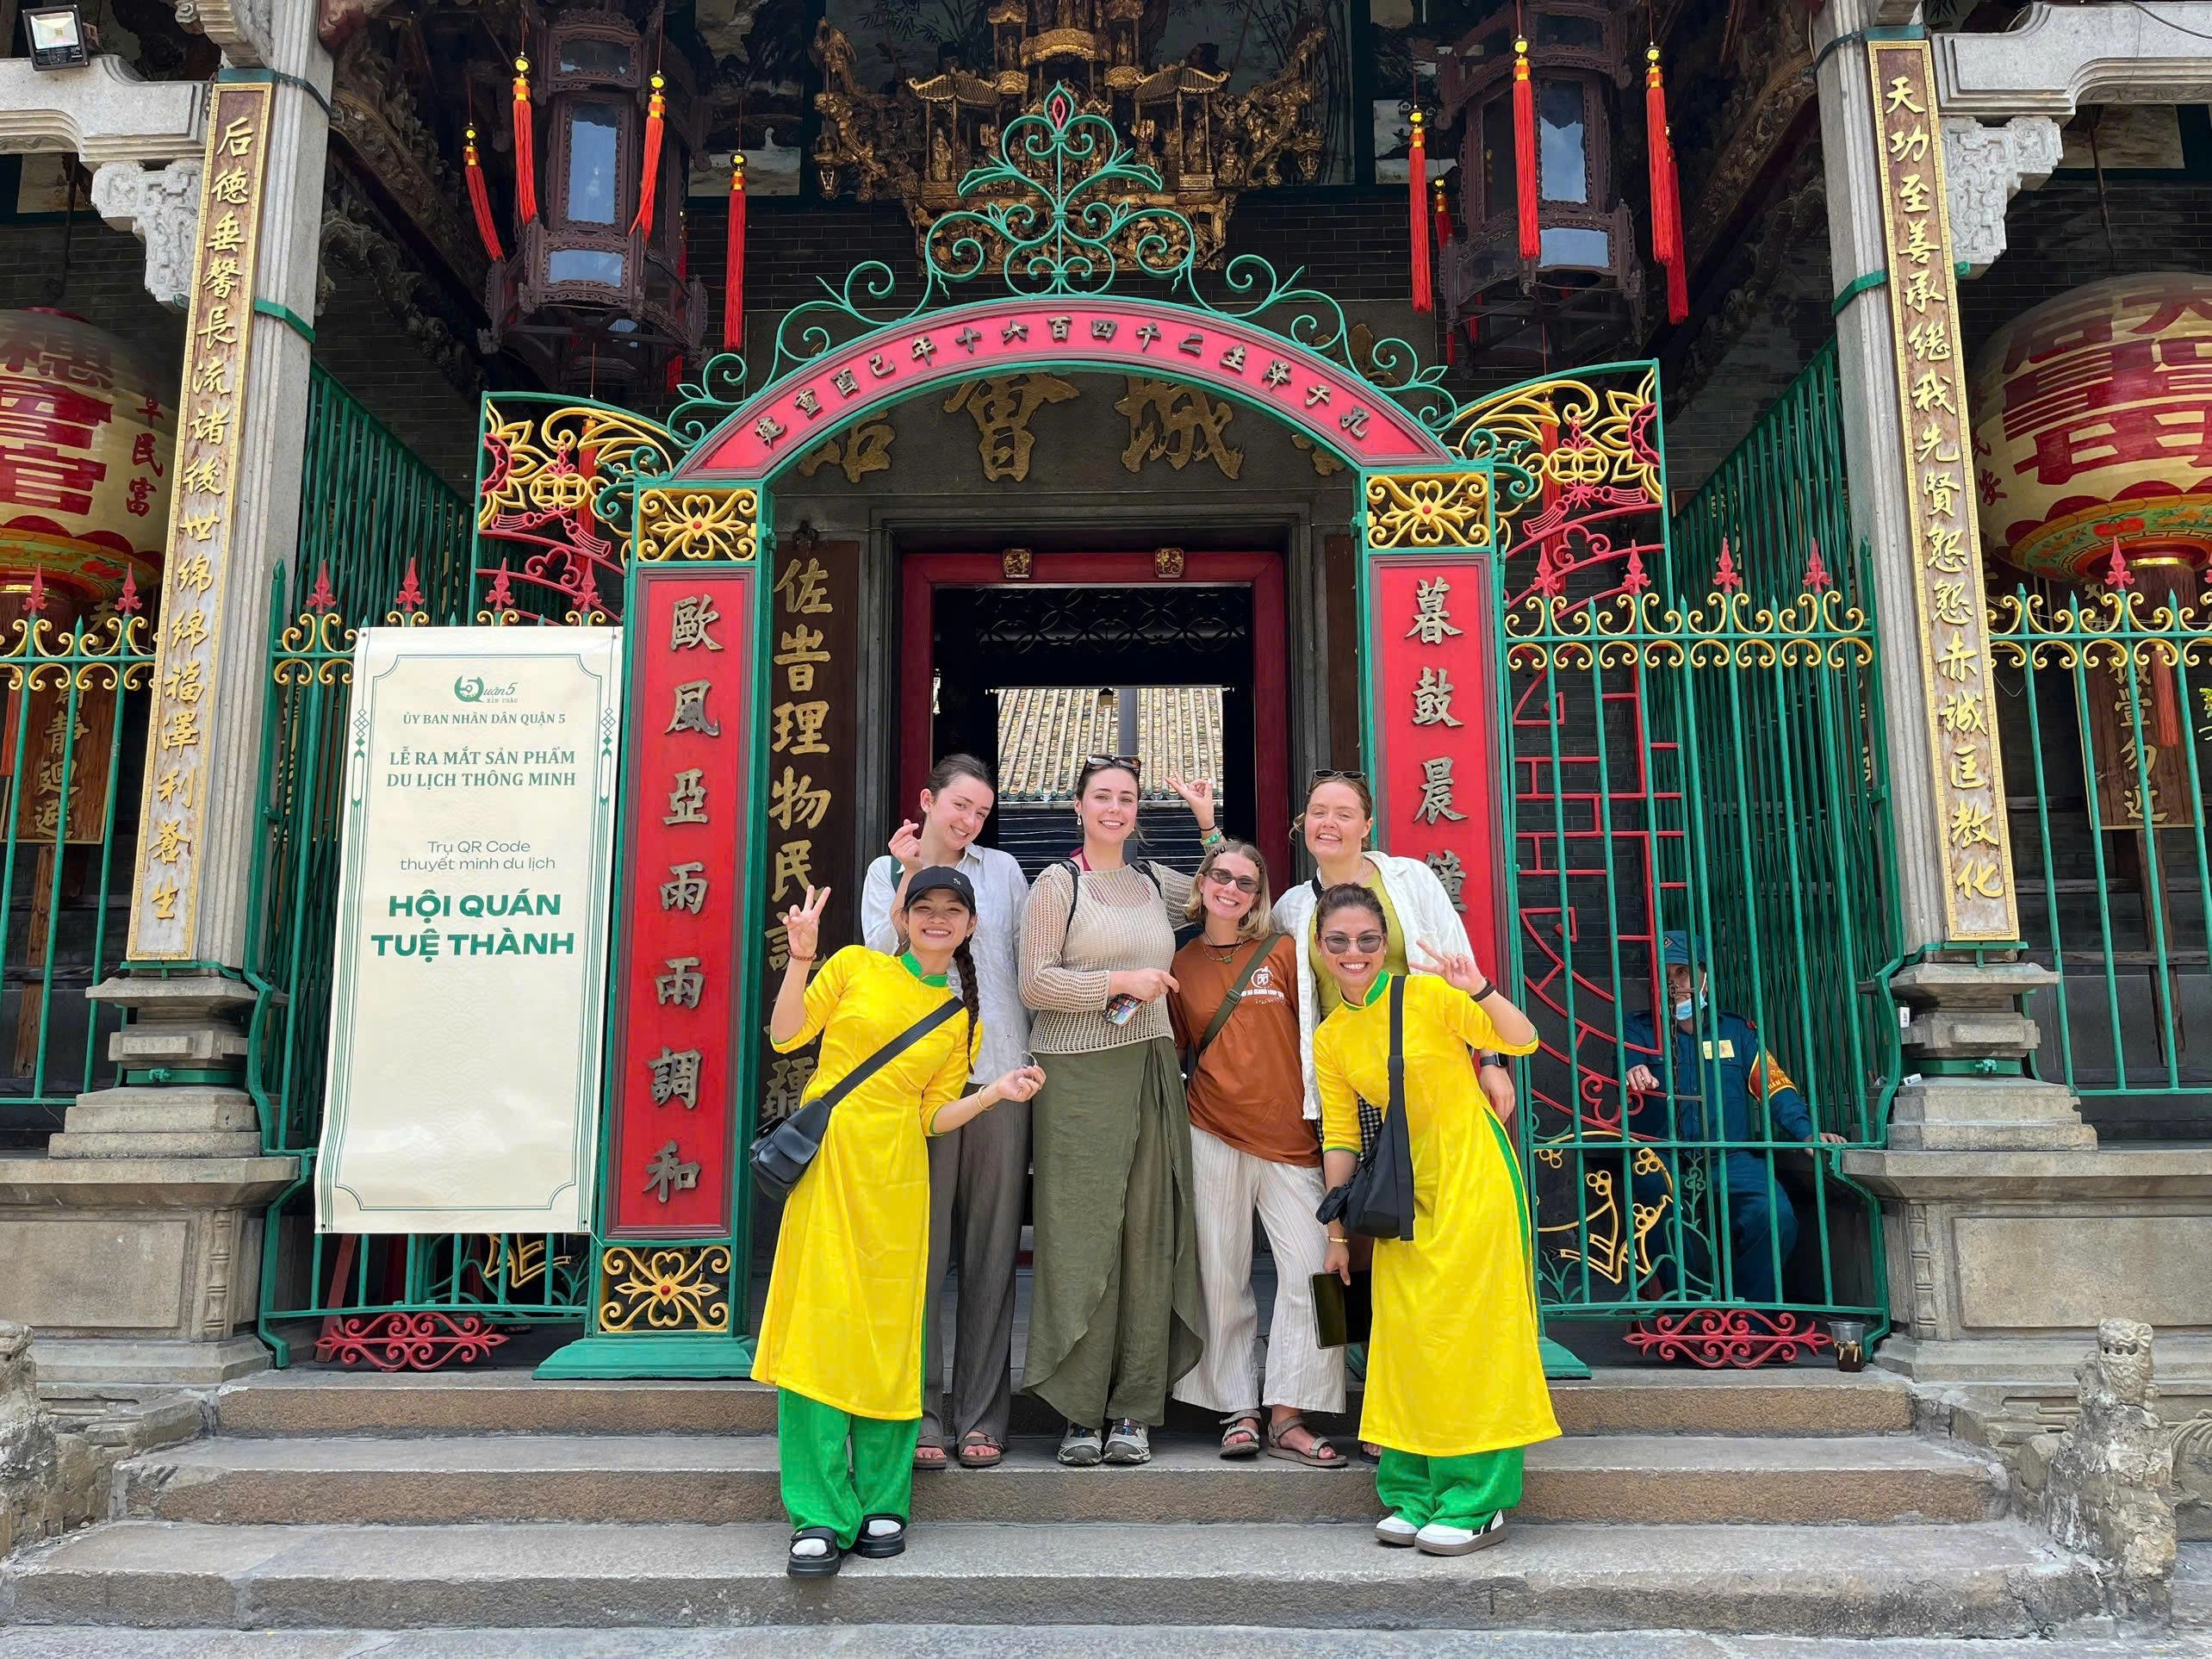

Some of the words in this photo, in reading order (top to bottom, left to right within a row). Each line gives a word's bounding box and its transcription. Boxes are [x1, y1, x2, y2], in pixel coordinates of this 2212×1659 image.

[402, 711, 420, 724] ỦY
[423, 714, 449, 724] BAN
[452, 711, 488, 724] NHÂN
[491, 711, 517, 724] DÂN
[520, 711, 556, 726] QUẬN
[558, 713, 566, 724] 5
[389, 746, 411, 766] LỄ
[414, 751, 438, 765] RA
[444, 746, 481, 765] MẮT
[485, 747, 518, 765] SẢN
[523, 746, 575, 765] PHẨM
[386, 773, 413, 787] DU
[416, 773, 457, 790] LỊCH
[462, 769, 524, 786] THÔNG
[528, 772, 576, 786] MINH
[427, 840, 453, 855] Trụ
[457, 840, 482, 854] QR
[486, 840, 531, 853] Code
[400, 855, 455, 872] thuyết
[459, 857, 499, 870] minh
[503, 857, 524, 870] du
[528, 857, 556, 872] lịch
[388, 889, 451, 923] HỘI
[458, 888, 562, 918] QUÁN
[642, 593, 724, 1203] 歐風亞雨雨調和
[370, 928, 440, 963] TUỆ
[447, 927, 575, 956] THÀNH
